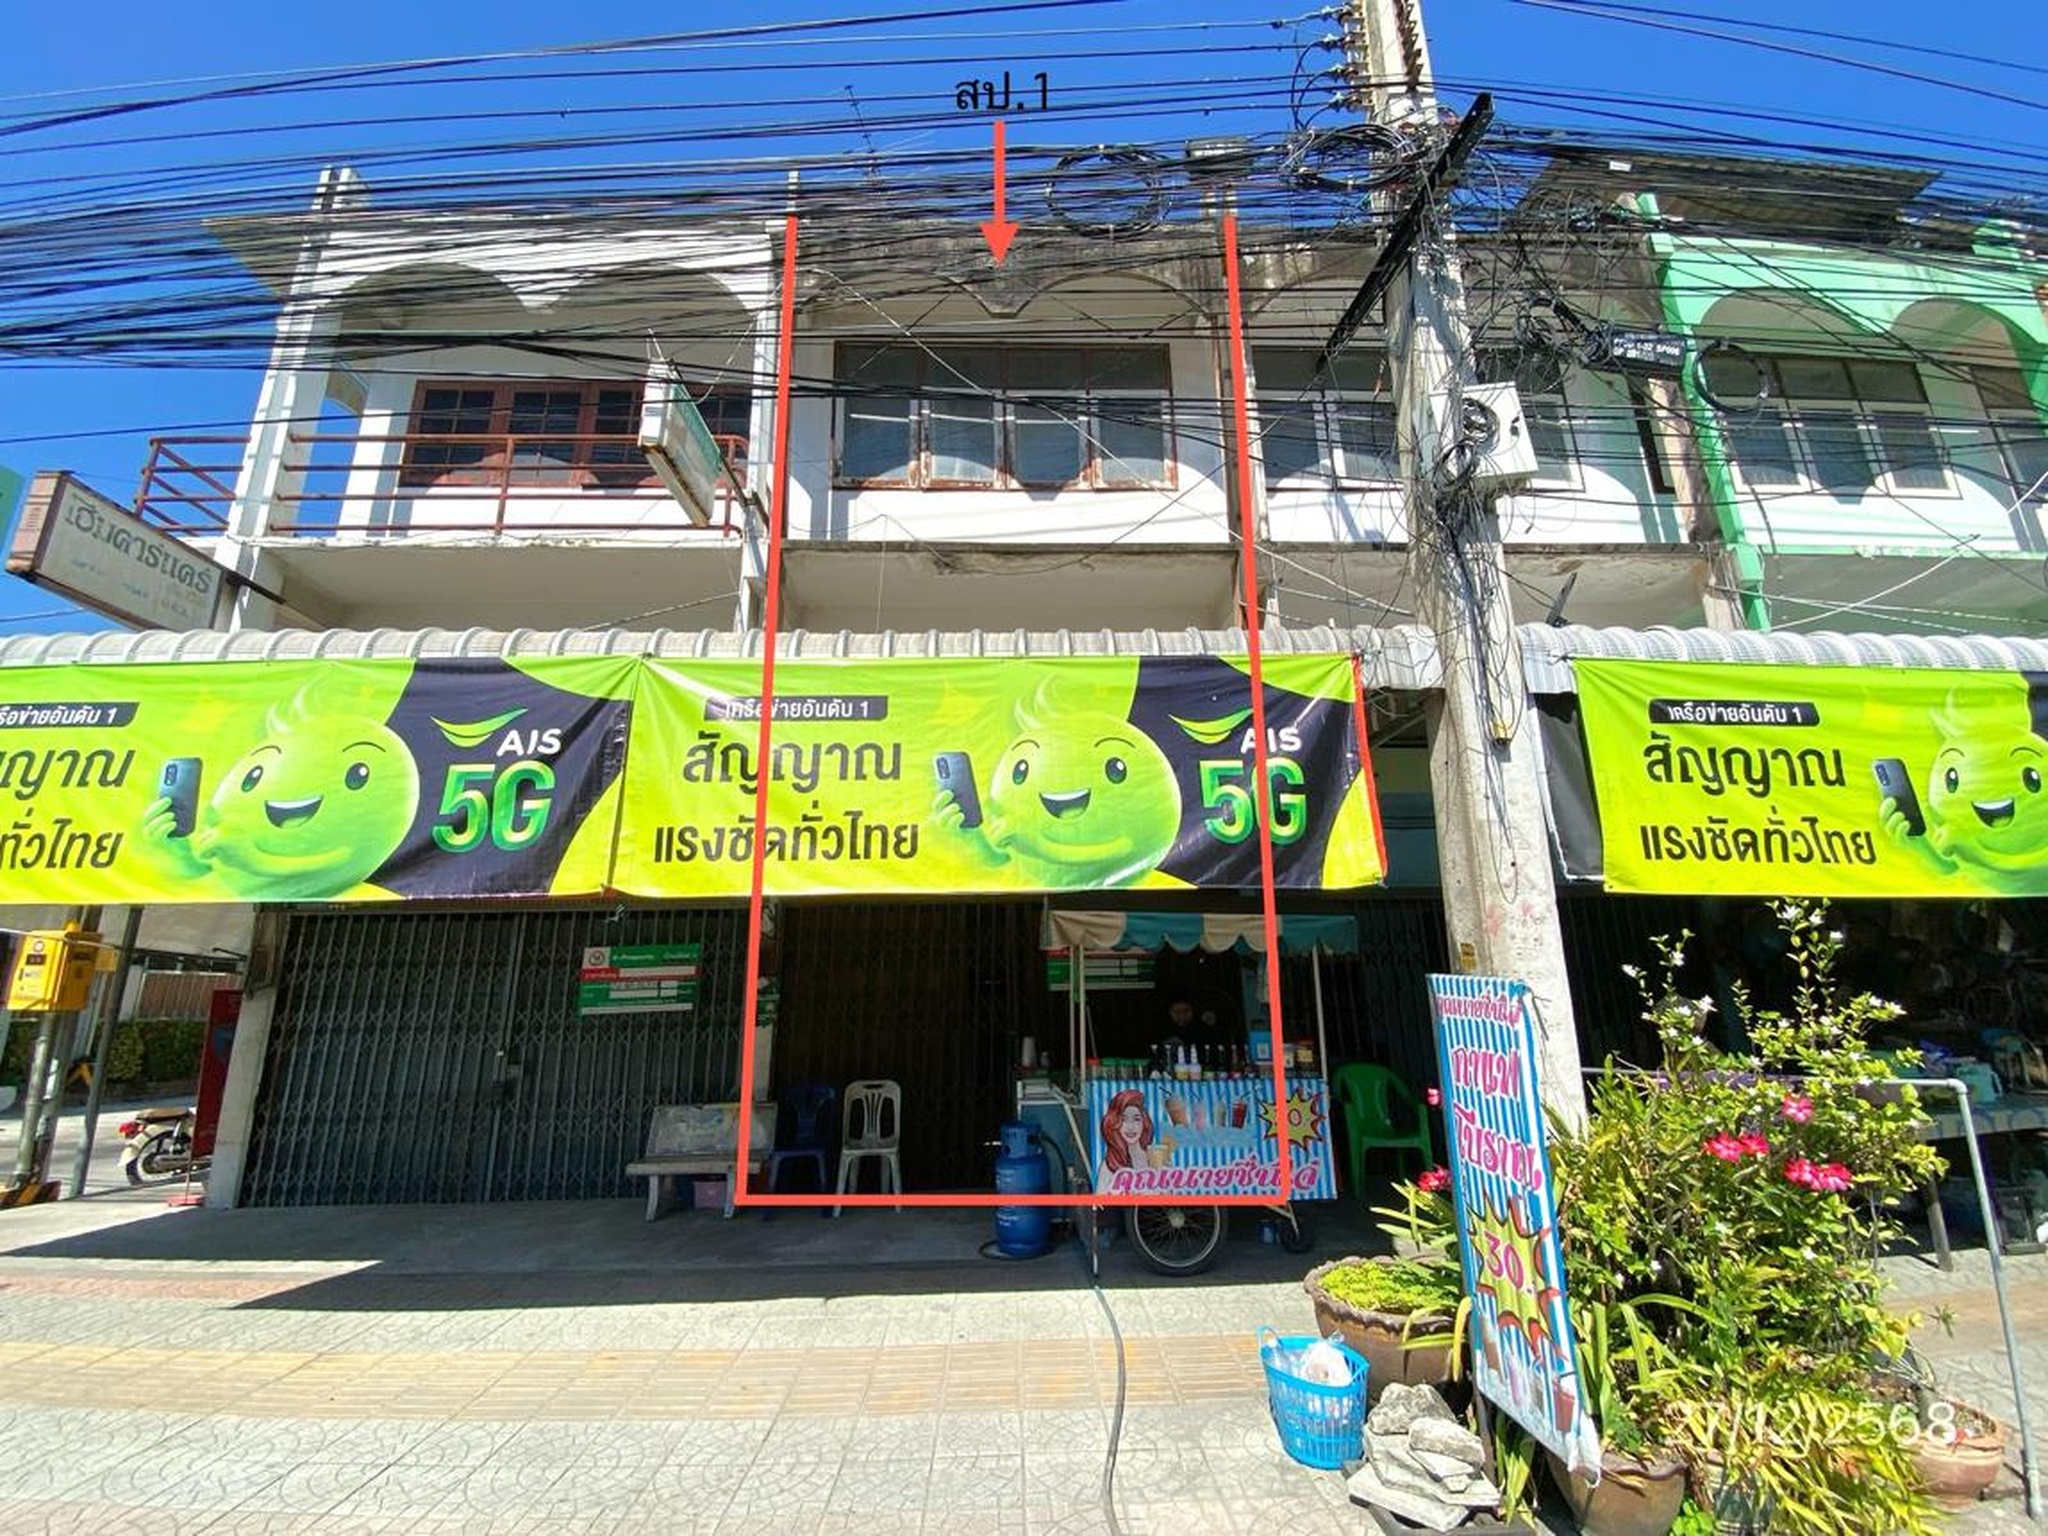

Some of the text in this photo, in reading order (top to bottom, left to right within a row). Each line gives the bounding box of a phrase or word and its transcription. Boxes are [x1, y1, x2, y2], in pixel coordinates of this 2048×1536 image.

[107, 706, 117, 724] 1
[859, 700, 869, 718] 1
[1667, 701, 1802, 723] เครือข่ายอันดับ 1
[496, 728, 562, 756] AIS
[683, 730, 901, 795] สัญญาณ
[1240, 727, 1302, 754] AIS
[1643, 730, 1846, 798] สัญญาณ
[0, 750, 136, 800] ญาณ
[1199, 757, 1306, 844] 5G
[432, 759, 555, 853] 5G
[654, 800, 919, 863] แรงชัดทั่วไทย
[1640, 804, 1877, 865] แรงชัดทั่วไทย
[1483, 1229, 1524, 1289] 30
